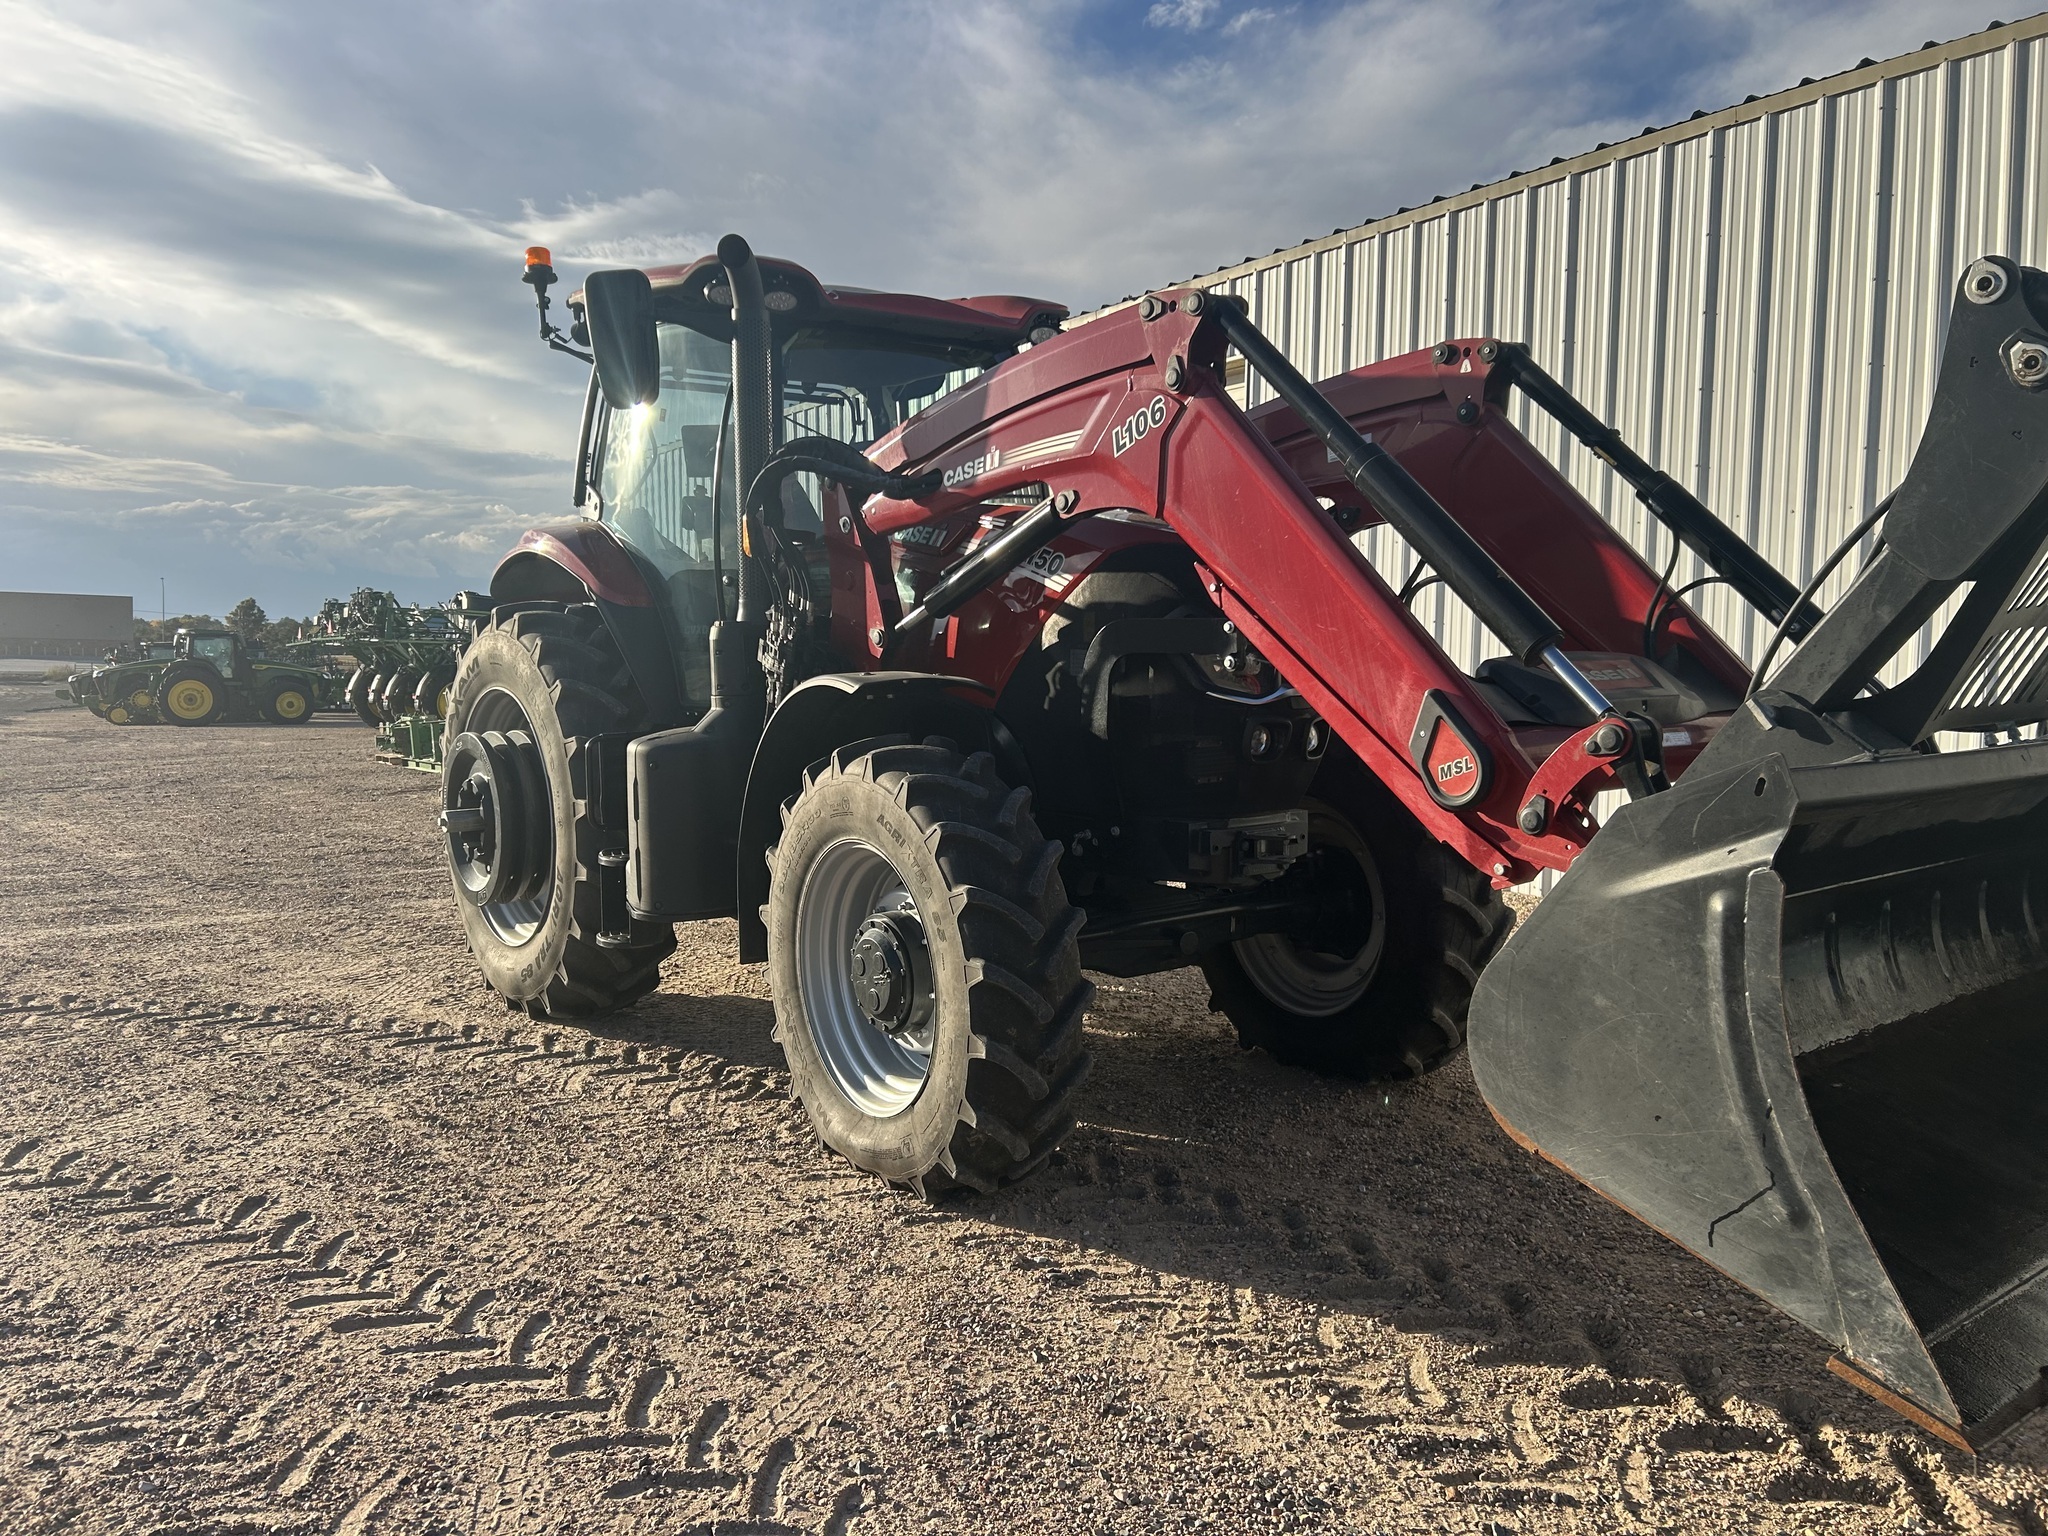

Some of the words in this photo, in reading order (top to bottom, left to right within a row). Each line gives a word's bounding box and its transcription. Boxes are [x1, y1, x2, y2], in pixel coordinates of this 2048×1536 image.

[1112, 395, 1166, 458] L106
[943, 456, 985, 487] CASE
[1438, 755, 1475, 782] MSL
[520, 963, 534, 984] 85
